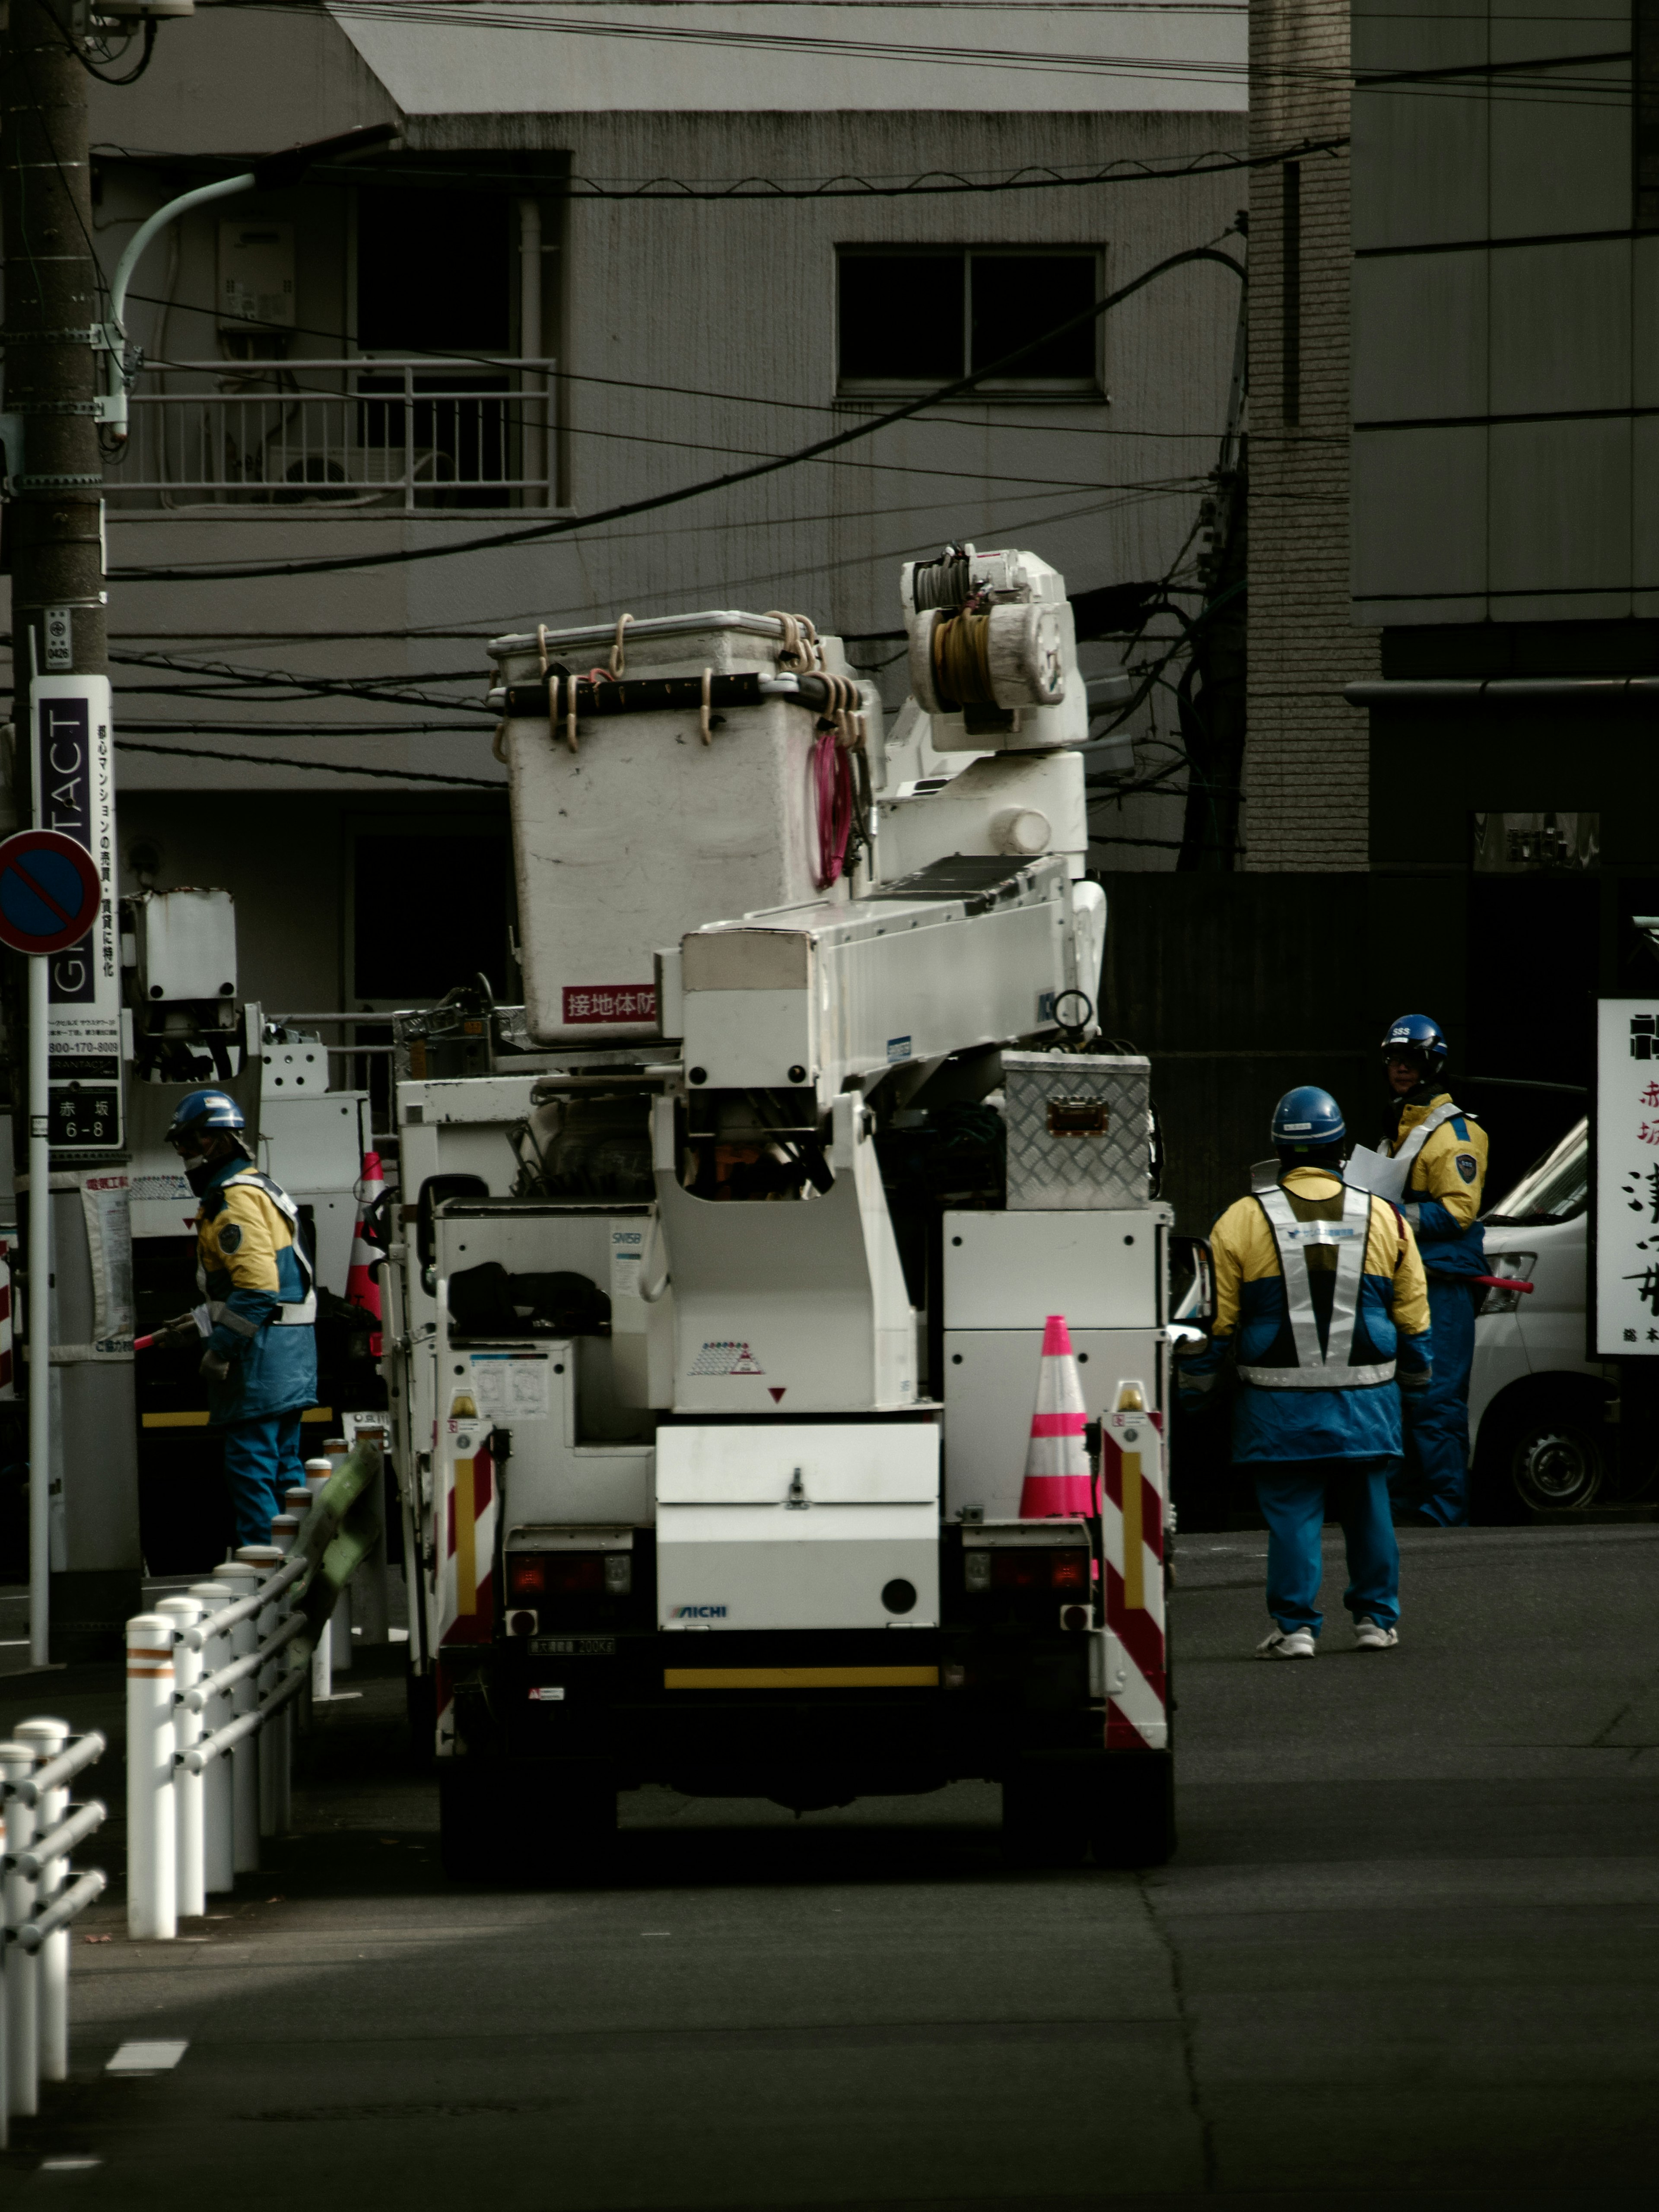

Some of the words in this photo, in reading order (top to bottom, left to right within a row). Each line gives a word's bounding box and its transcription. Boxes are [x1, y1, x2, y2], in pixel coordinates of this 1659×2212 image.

[49, 709, 86, 995] GTACT
[1392, 1027, 1411, 1036] SSS
[59, 1101, 110, 1117] 赤坂
[66, 1121, 103, 1138] 6-8
[677, 1606, 727, 1618] AICHI
